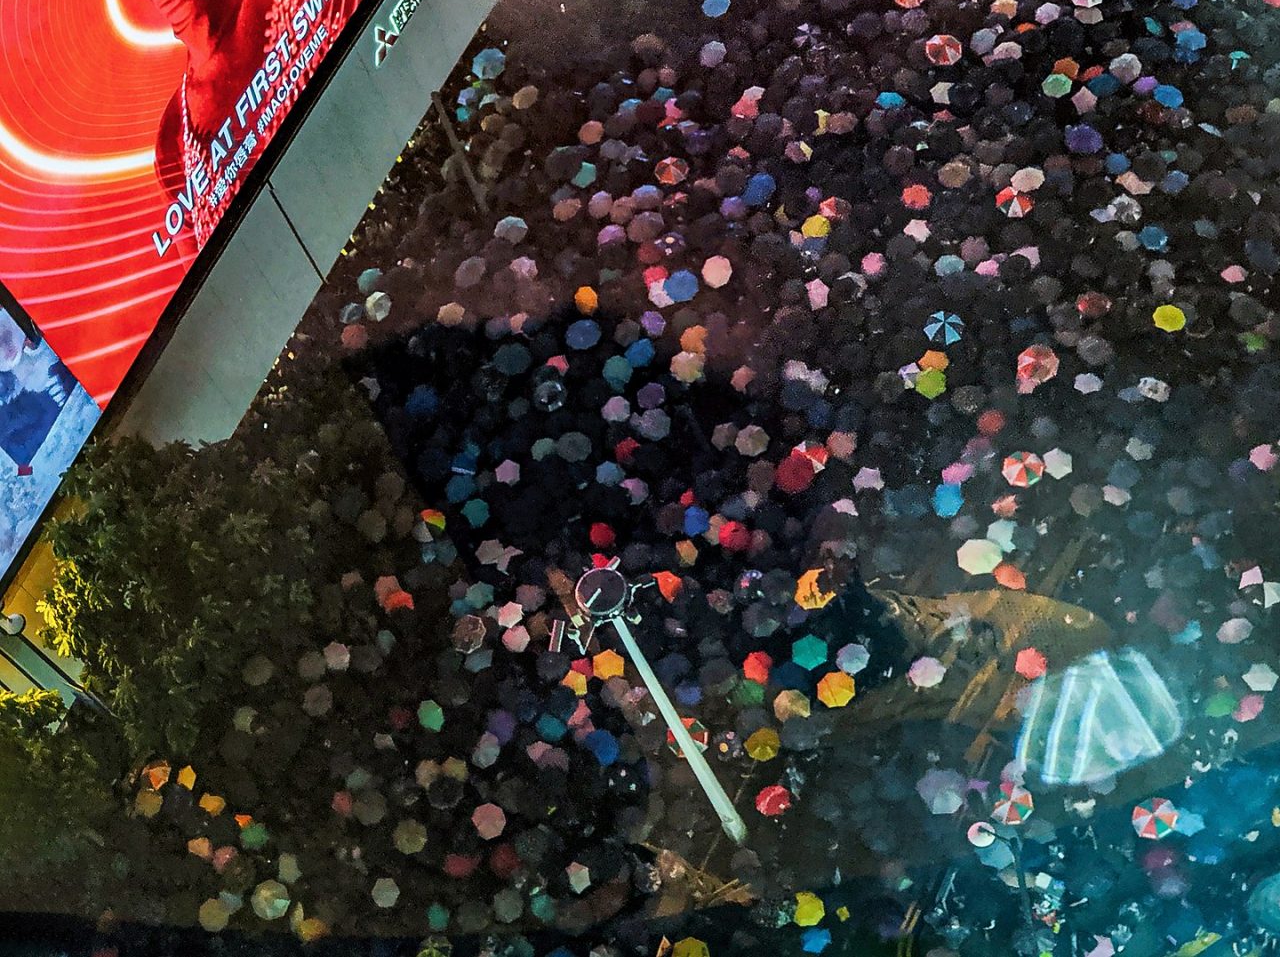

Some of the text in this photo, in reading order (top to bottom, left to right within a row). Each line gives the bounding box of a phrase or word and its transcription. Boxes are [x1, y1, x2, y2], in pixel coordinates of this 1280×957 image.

[152, 159, 210, 257] LOVE
[209, 117, 234, 173] AT
[234, 31, 291, 129] FIRST
[257, 24, 328, 136] #MACLOVEME
